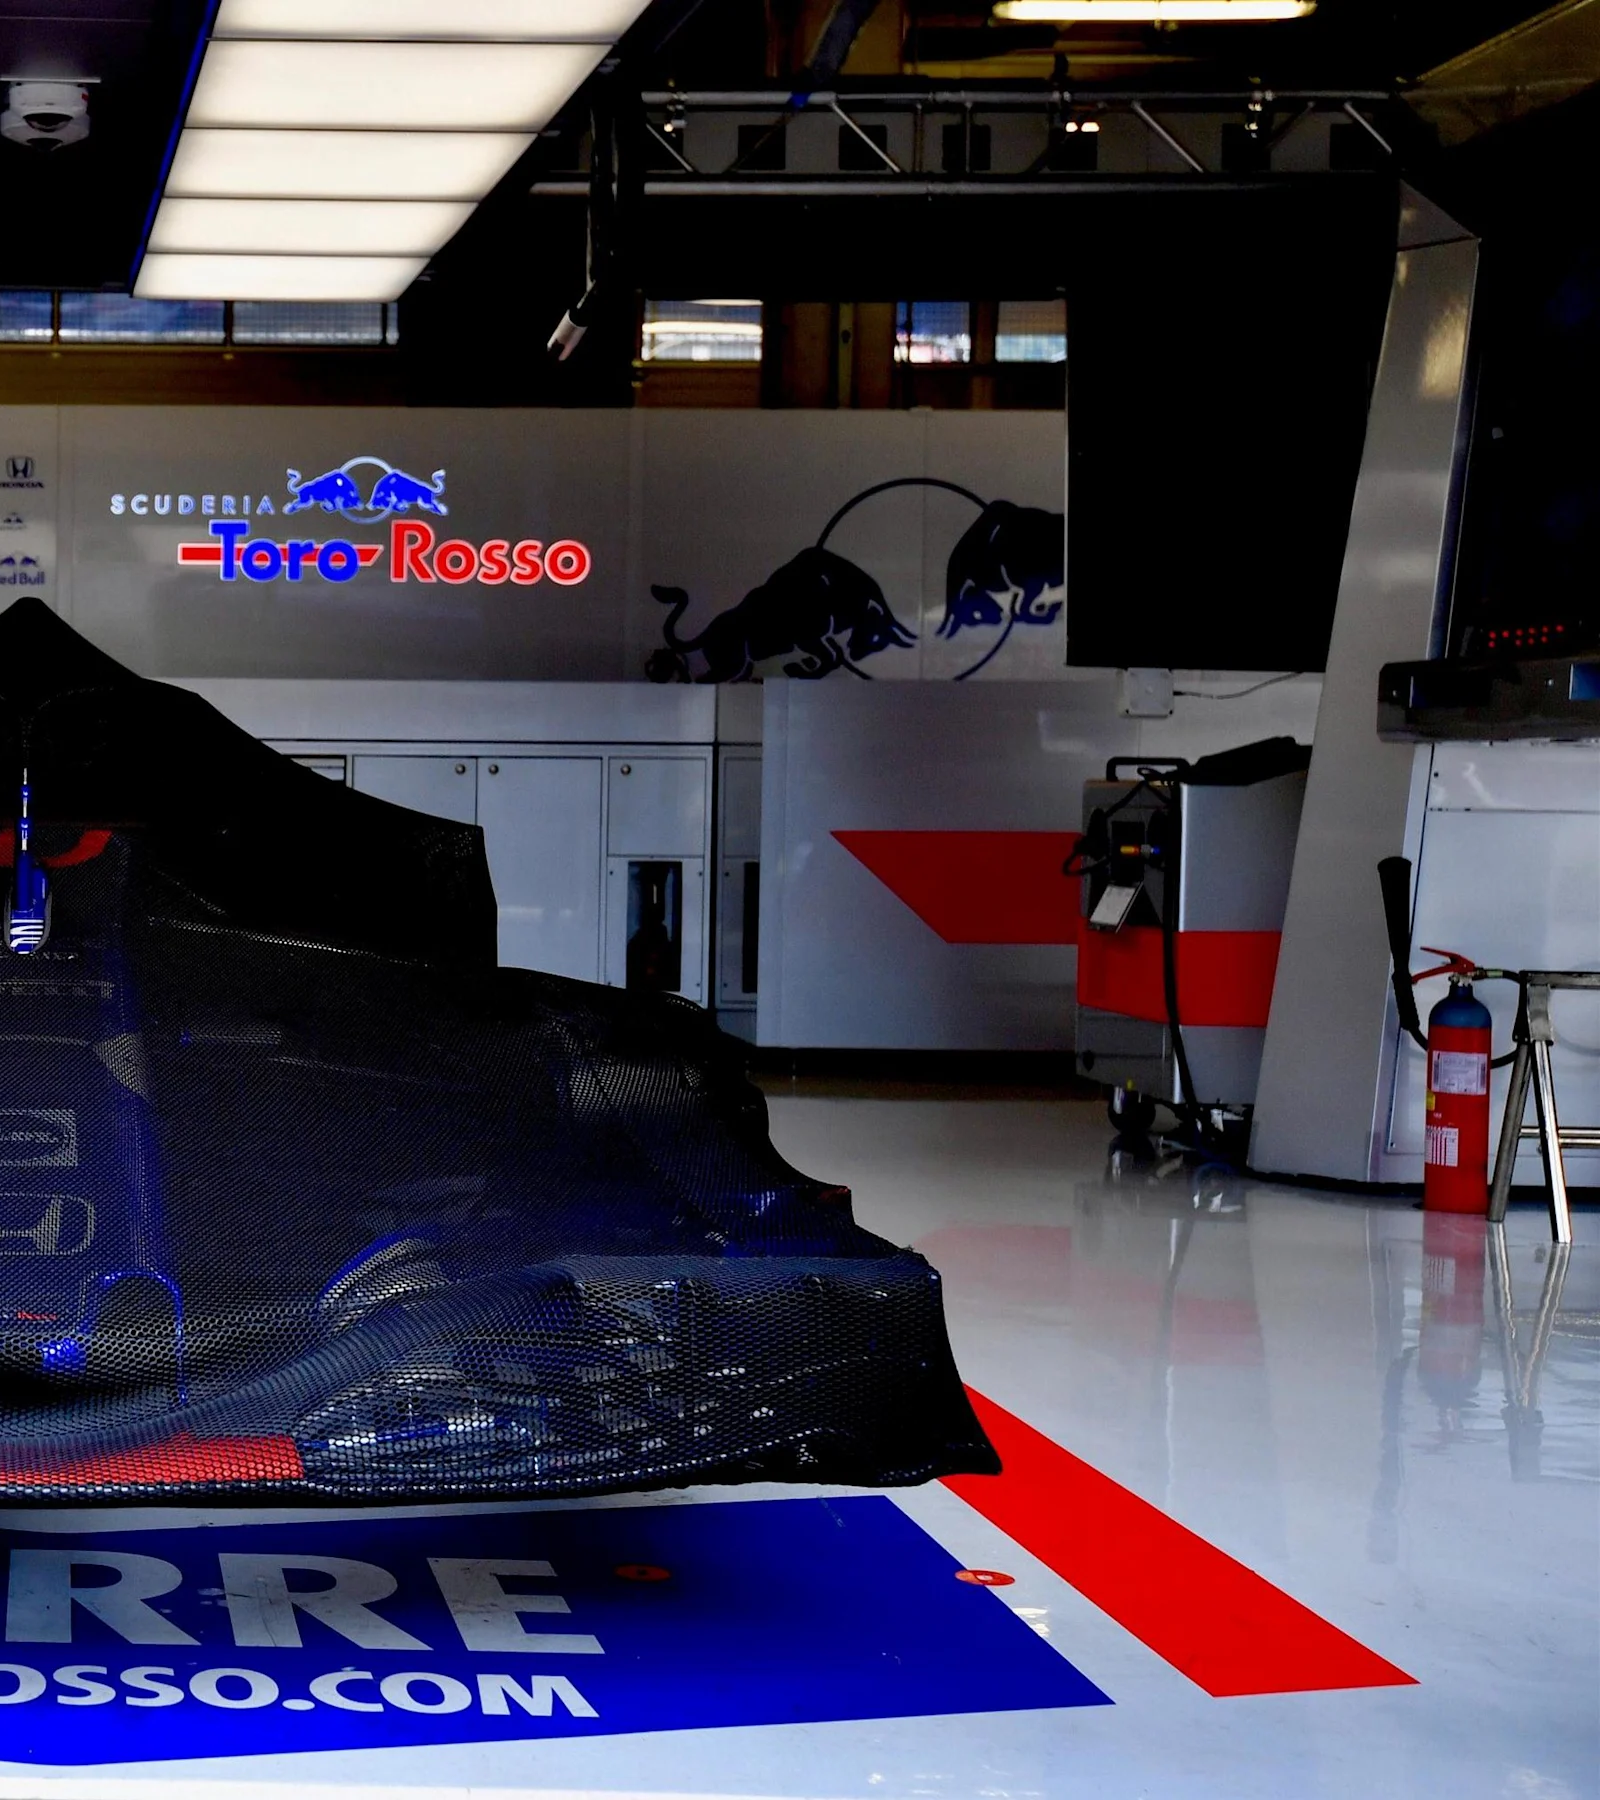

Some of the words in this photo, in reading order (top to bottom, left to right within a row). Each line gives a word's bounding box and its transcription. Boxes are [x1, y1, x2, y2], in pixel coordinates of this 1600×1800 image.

[110, 494, 274, 515] SCUDERIA
[208, 519, 361, 582] Toro
[390, 519, 592, 586] Rosso
[19, 571, 45, 585] Bull
